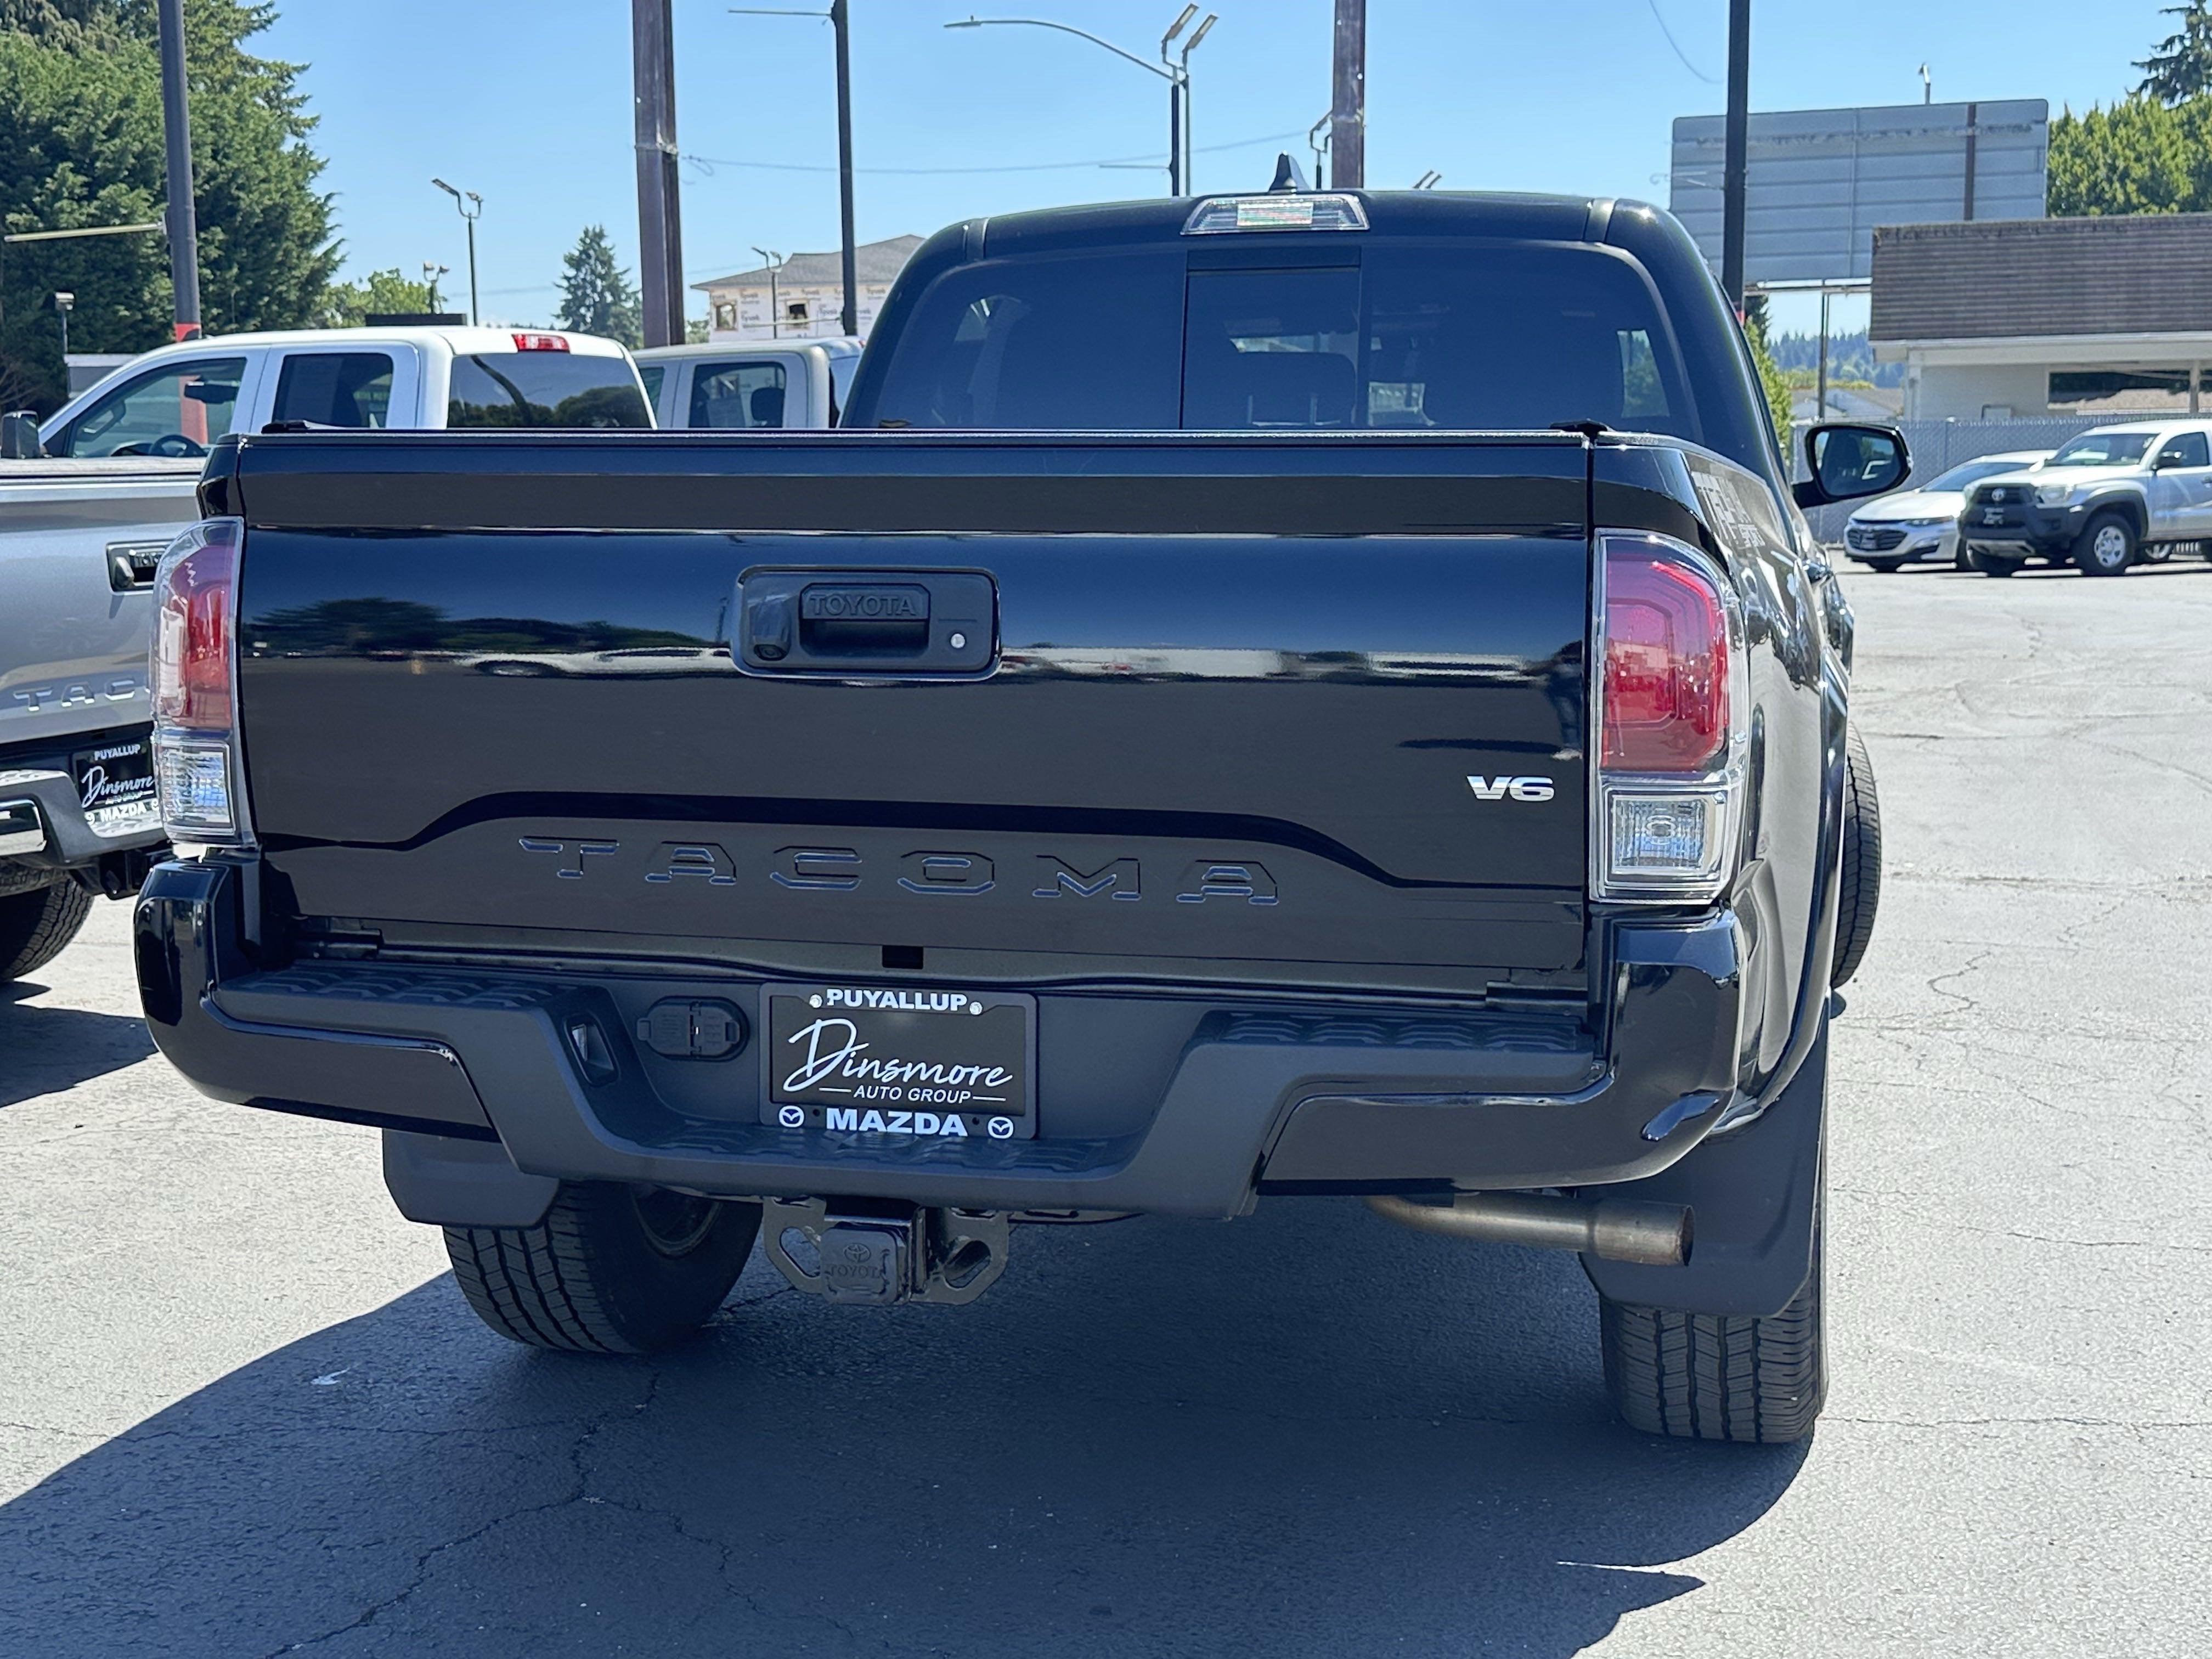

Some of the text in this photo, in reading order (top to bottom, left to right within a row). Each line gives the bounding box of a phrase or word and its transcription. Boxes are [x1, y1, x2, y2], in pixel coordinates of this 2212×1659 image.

[809, 594, 917, 617] TOYOTA
[13, 678, 151, 712] TAC
[94, 743, 141, 761] PUYALLUP
[81, 765, 155, 809] Dinsmore
[1466, 775, 1555, 802] V6
[99, 800, 147, 822] MAZDA
[518, 835, 1279, 905] TACOMA
[826, 988, 968, 1012] PUYALLUP
[782, 1017, 1013, 1093] Dinsmore
[853, 1085, 972, 1104] AUTO GROUP
[826, 1107, 968, 1137] MAZDA
